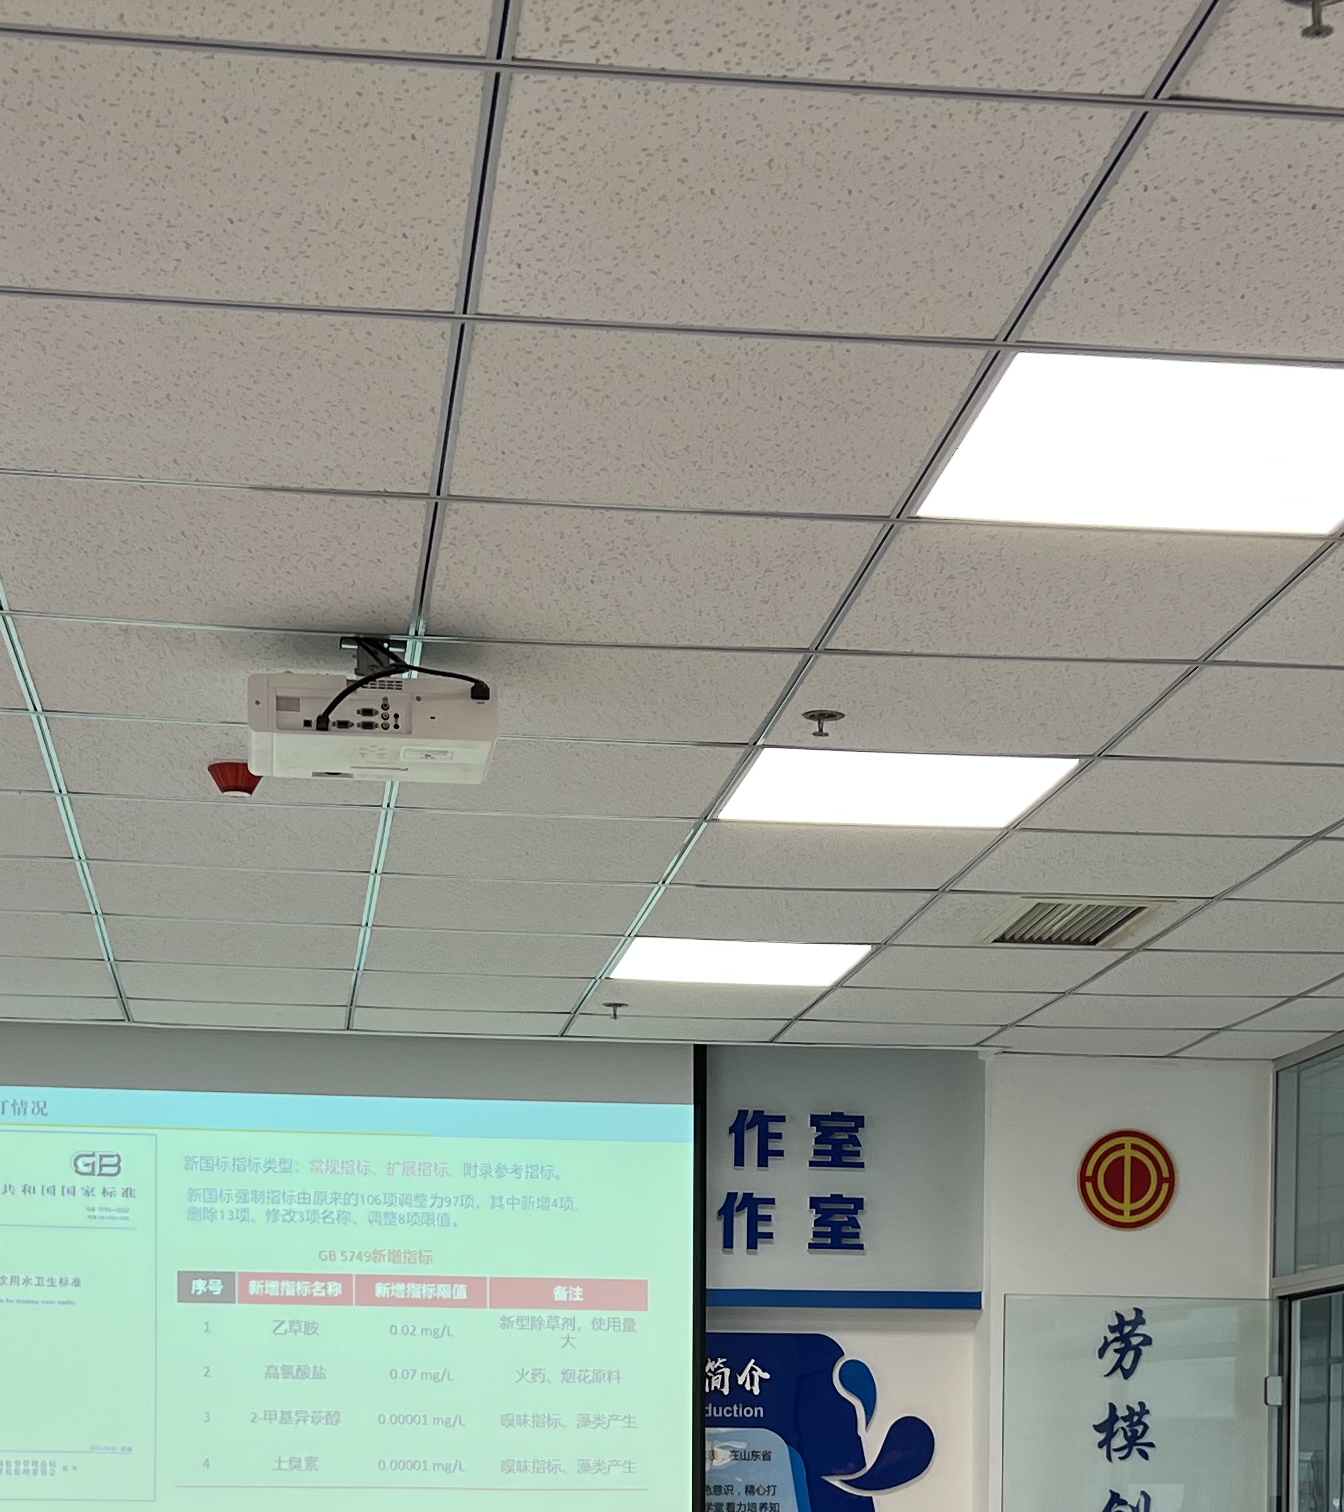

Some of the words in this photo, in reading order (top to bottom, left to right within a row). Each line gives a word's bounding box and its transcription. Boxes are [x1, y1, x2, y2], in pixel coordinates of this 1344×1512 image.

[727, 1109, 866, 1170] 作室
[70, 1150, 122, 1177] GB
[716, 1191, 866, 1252] 作室
[318, 1250, 337, 1263] GB
[190, 1278, 224, 1297] 序号
[248, 1279, 343, 1299] 新增指标名称
[375, 1282, 468, 1302] 新增指标限值
[552, 1285, 585, 1304] 备注
[272, 1319, 320, 1337] 乙草胺
[389, 1324, 418, 1337] 0.02
[420, 1323, 454, 1340] mg/L
[560, 1334, 577, 1350] 大
[389, 1368, 418, 1381] 0.07
[420, 1368, 454, 1384] mg/L
[515, 1367, 623, 1386] 火药、烟花原料
[705, 1357, 771, 1395] 简介
[377, 1414, 429, 1427] 0.00001
[432, 1414, 466, 1429] mg/L
[377, 1460, 429, 1472] 0.00001
[432, 1459, 466, 1474] mg/L
